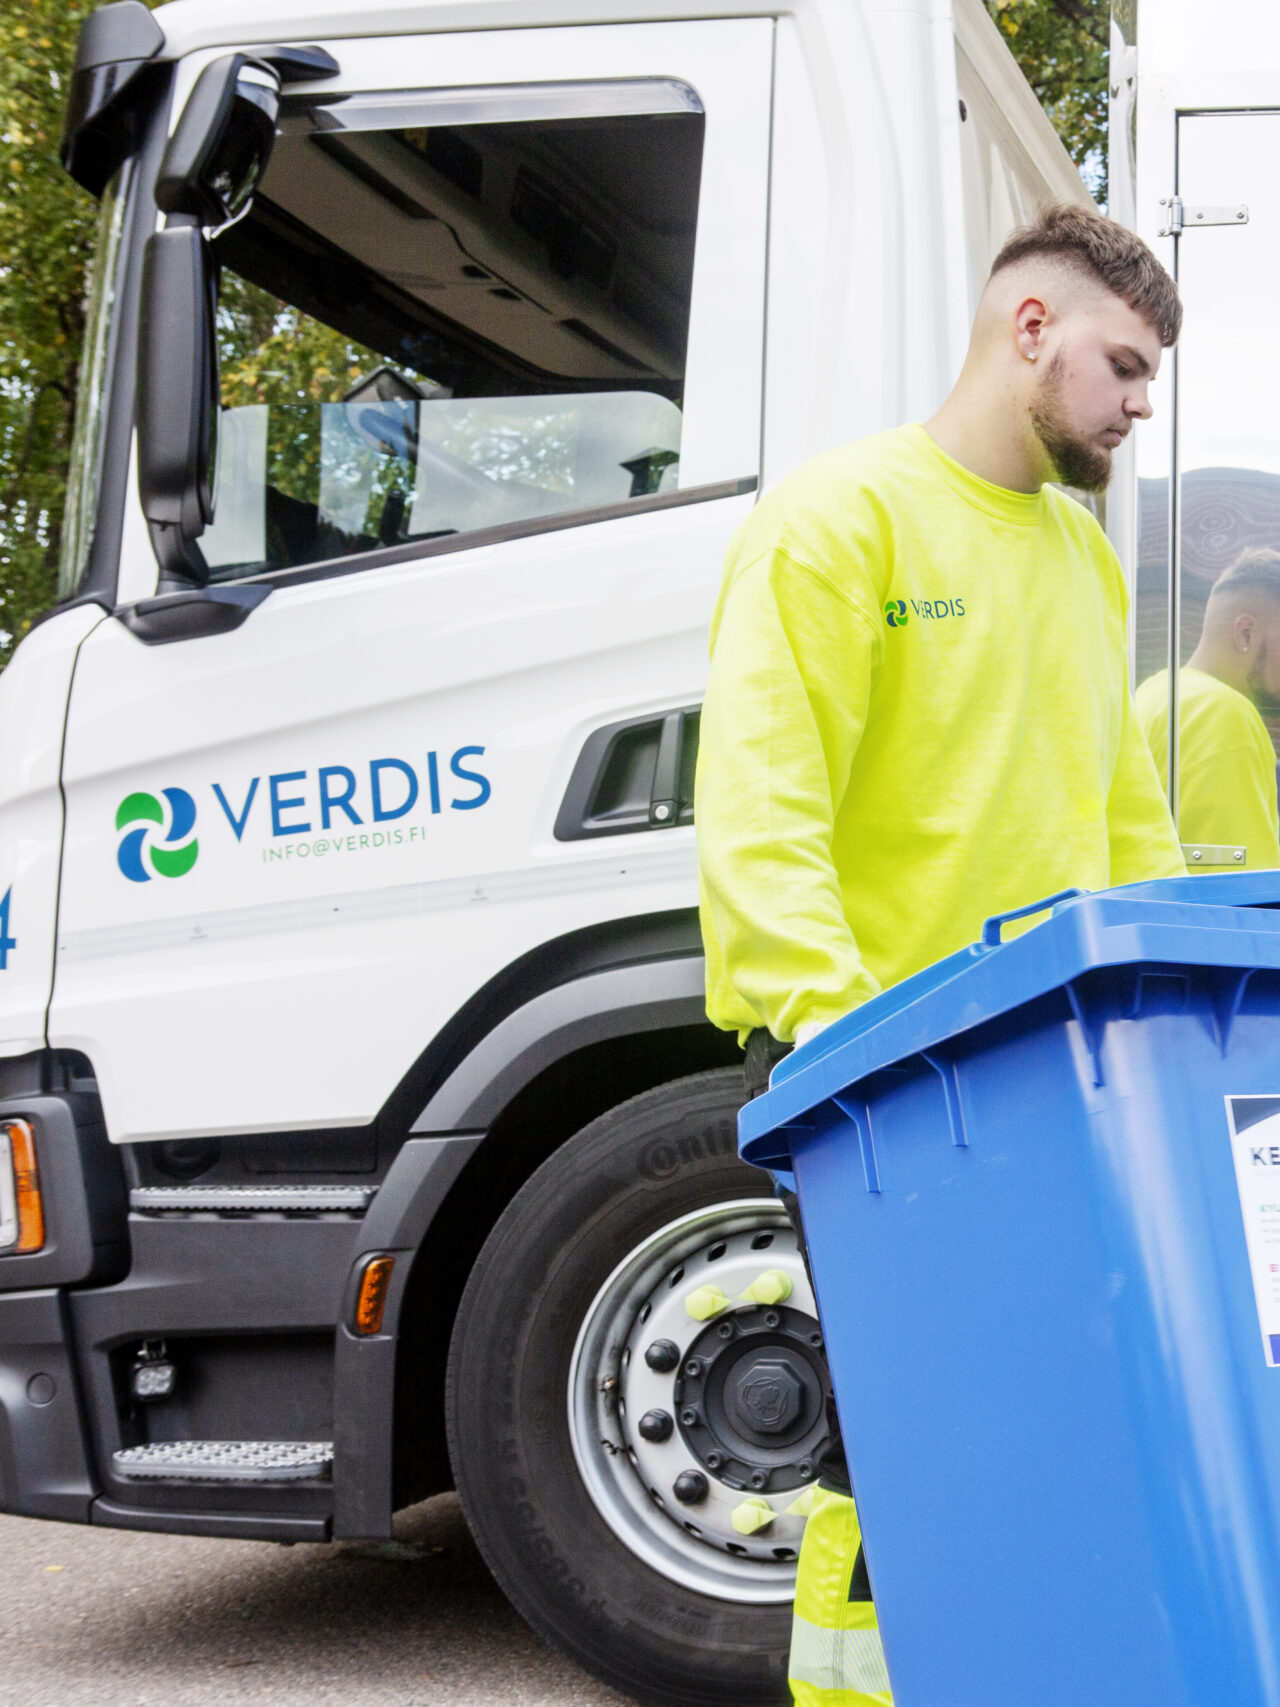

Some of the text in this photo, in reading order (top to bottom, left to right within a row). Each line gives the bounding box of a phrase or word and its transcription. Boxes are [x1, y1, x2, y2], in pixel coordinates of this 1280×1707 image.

[910, 598, 966, 620] VERDIS
[211, 745, 491, 843] VERDIS
[262, 826, 427, 864] INFO@VERDIS.FI
